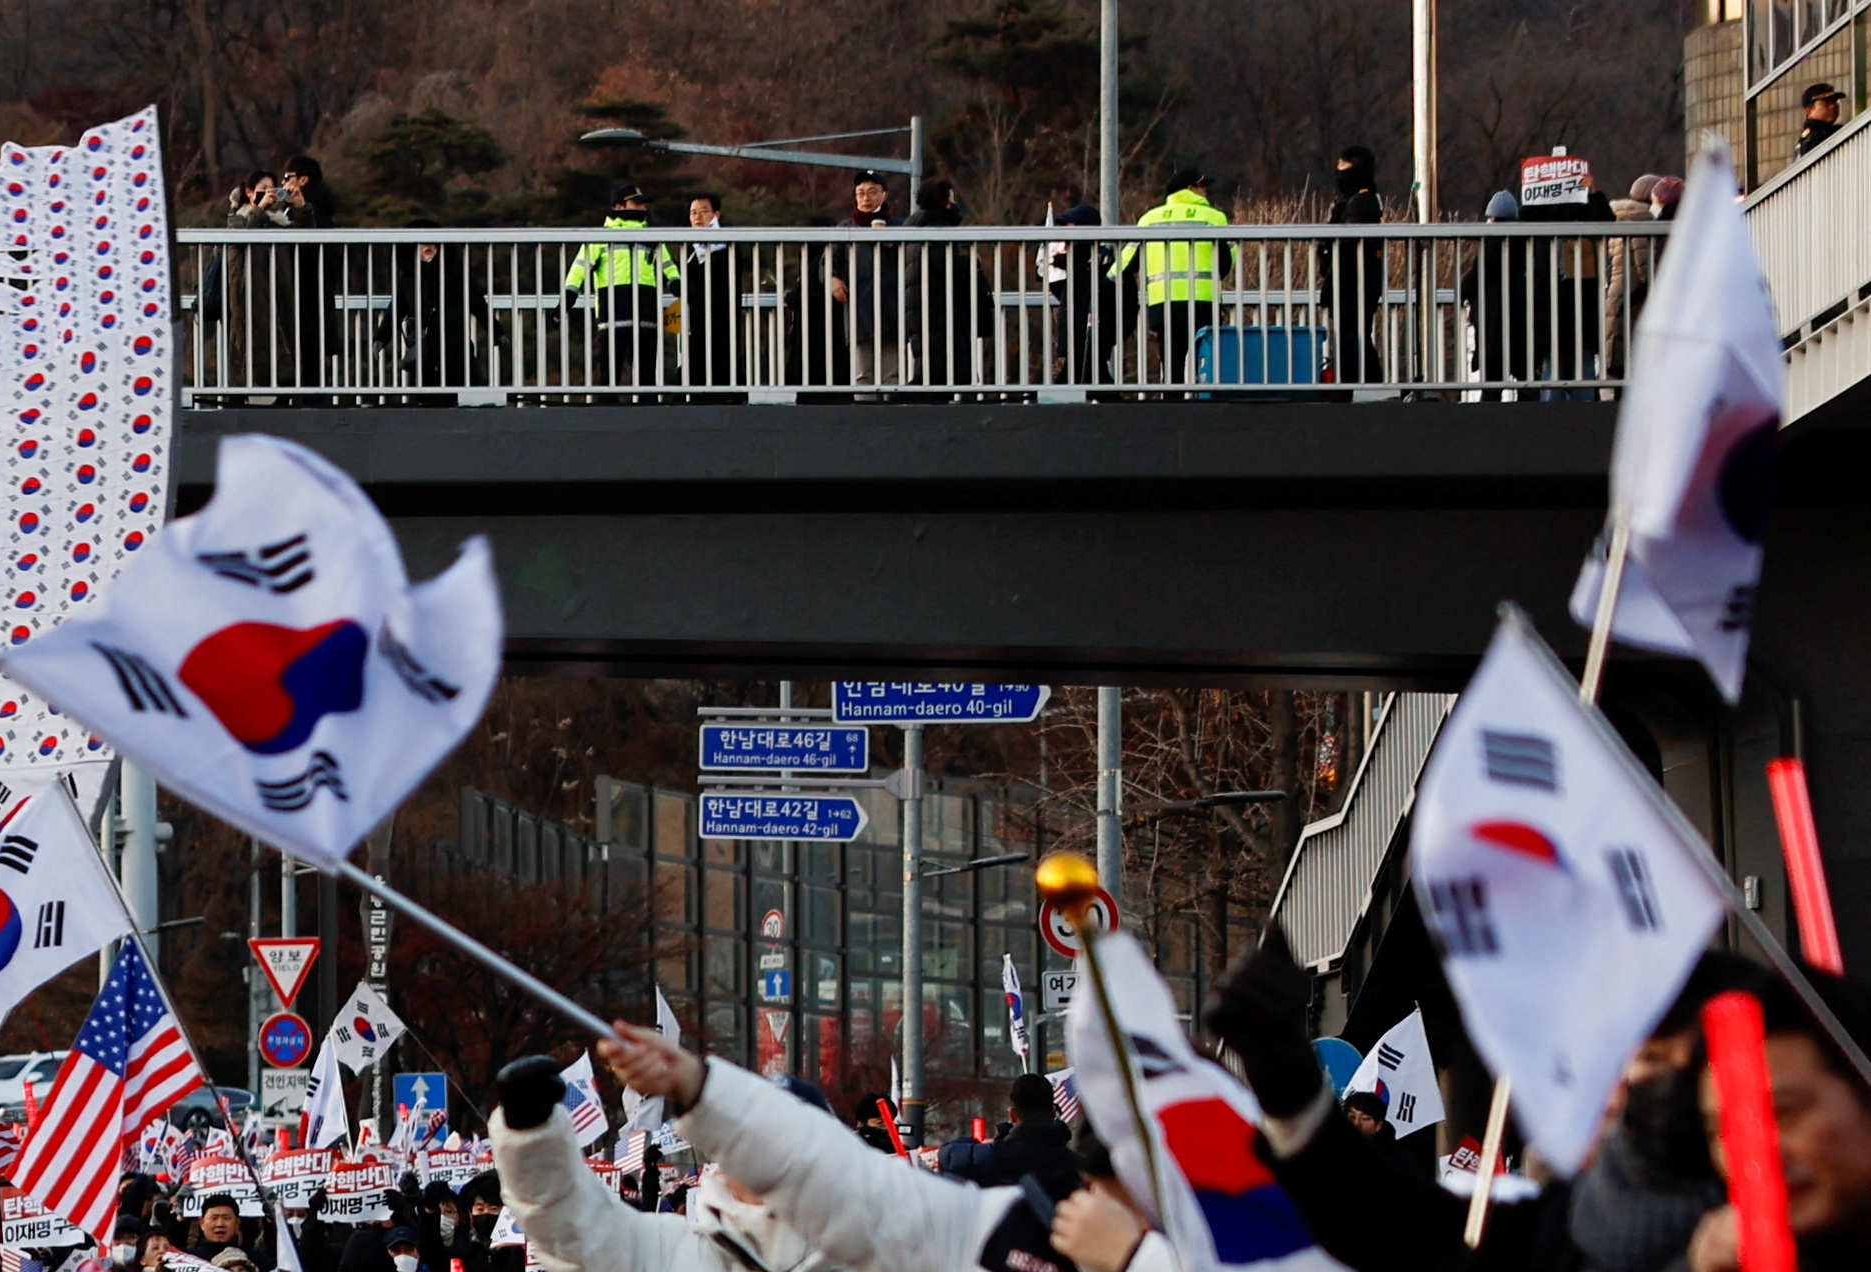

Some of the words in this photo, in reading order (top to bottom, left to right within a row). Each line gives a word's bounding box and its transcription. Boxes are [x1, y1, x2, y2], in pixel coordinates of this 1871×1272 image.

[1524, 160, 1588, 183] 탄핵반대
[1524, 182, 1563, 201] 이재명
[1564, 179, 1586, 194] 구
[841, 701, 962, 716] Hannam-daero
[966, 700, 1012, 718] 40-gil
[719, 730, 832, 750] 한남대로46길
[846, 733, 858, 743] 68
[713, 753, 800, 766] Hannam-daero
[802, 753, 837, 768] 46-gil
[706, 799, 819, 821] 한남대로42길
[706, 821, 800, 834] Hannam-daero
[802, 822, 838, 838] 42-gil
[766, 920, 780, 937] 30
[269, 951, 302, 964] 양보
[272, 964, 300, 972] YIELD
[264, 1074, 310, 1090] 견인지역
[5, 1220, 51, 1243] 이재명
[53, 1217, 82, 1235] 구
